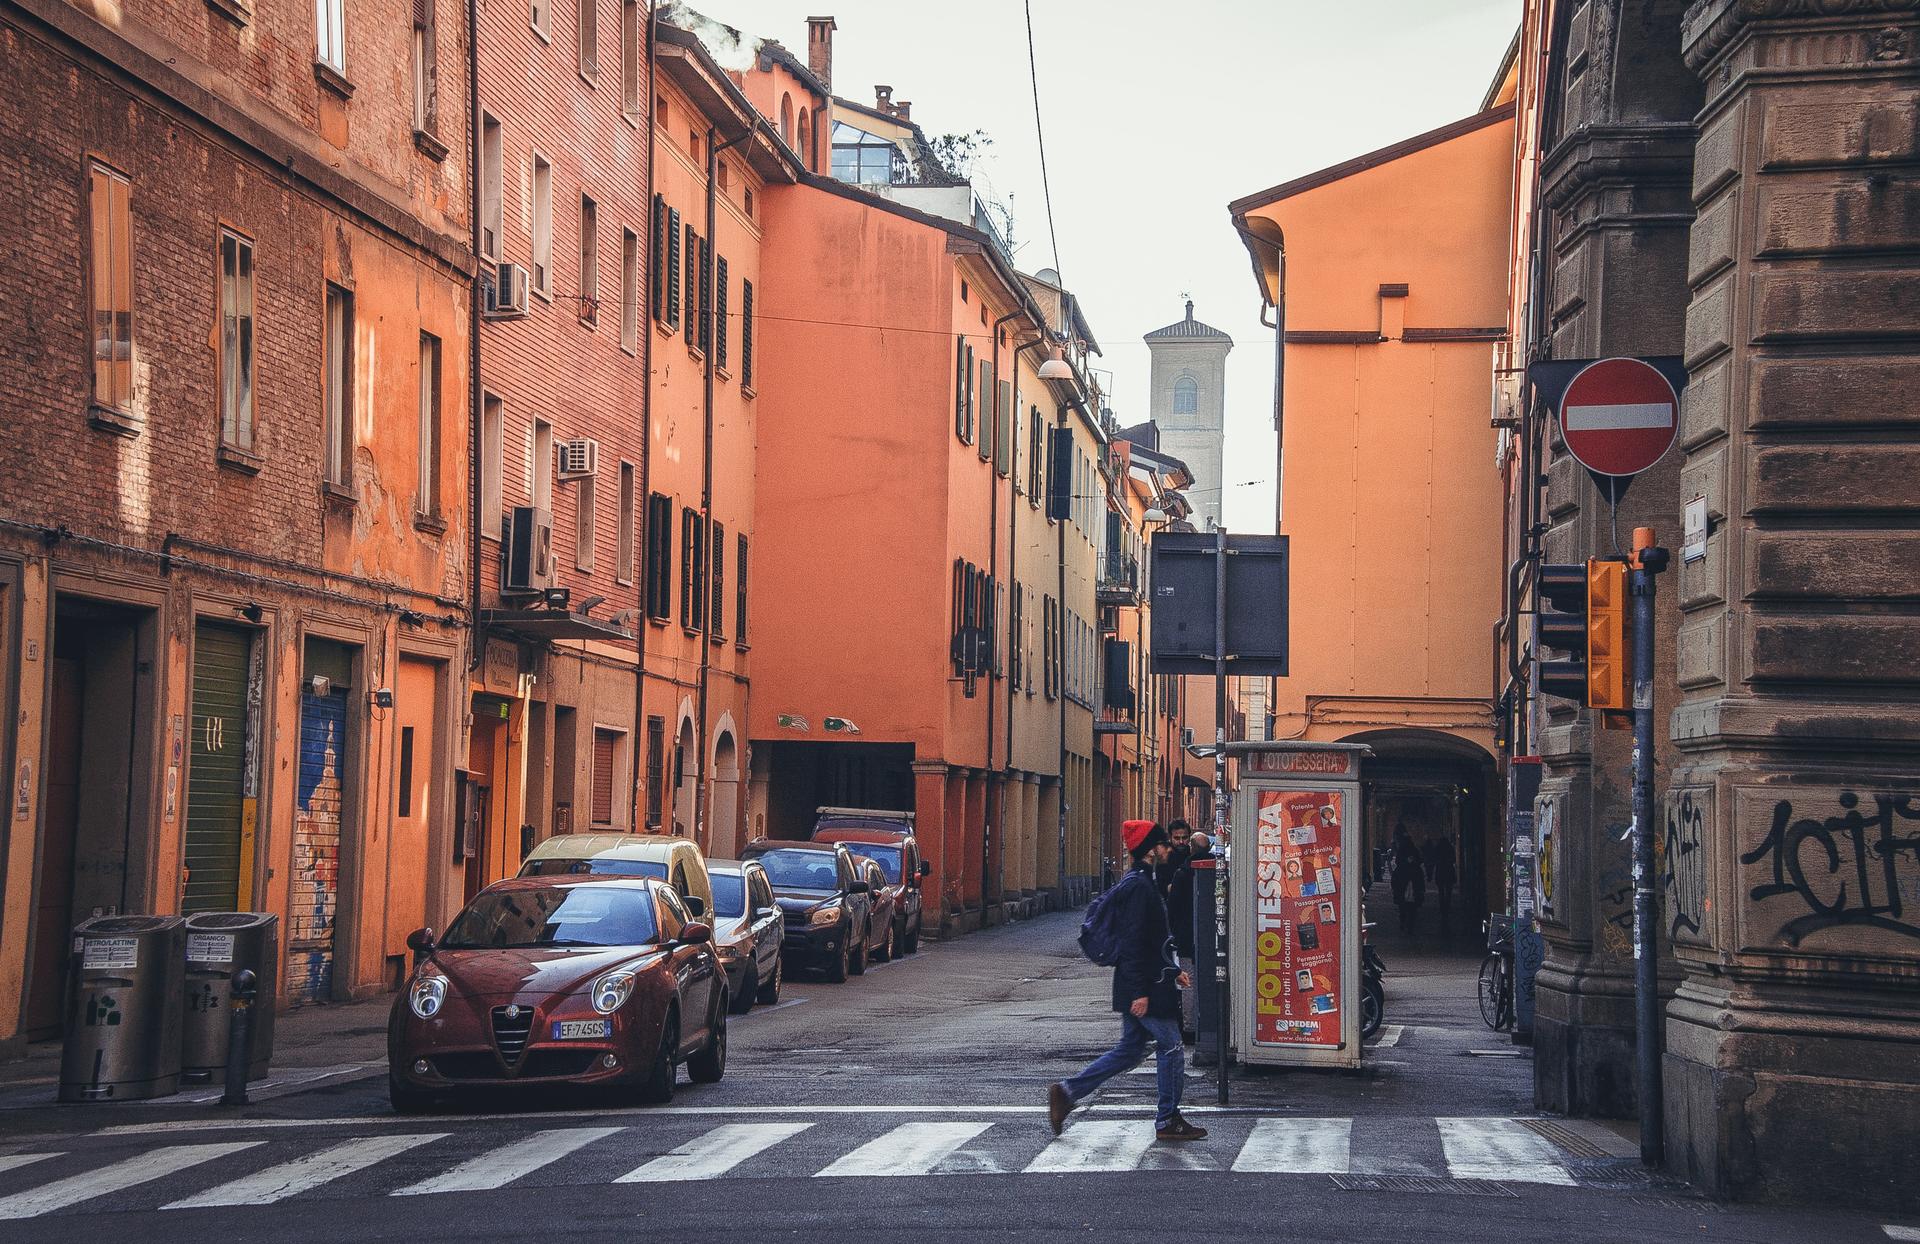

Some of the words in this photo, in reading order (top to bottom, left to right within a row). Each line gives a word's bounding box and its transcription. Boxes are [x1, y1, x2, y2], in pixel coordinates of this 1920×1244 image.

[1294, 897, 1329, 907] Passaporto
[193, 934, 226, 942] ORGANICO
[1282, 919, 1291, 969] documenti
[1282, 978, 1291, 996] tutti
[1283, 999, 1293, 1016] per
[1289, 1020, 1319, 1029] DEDEM
